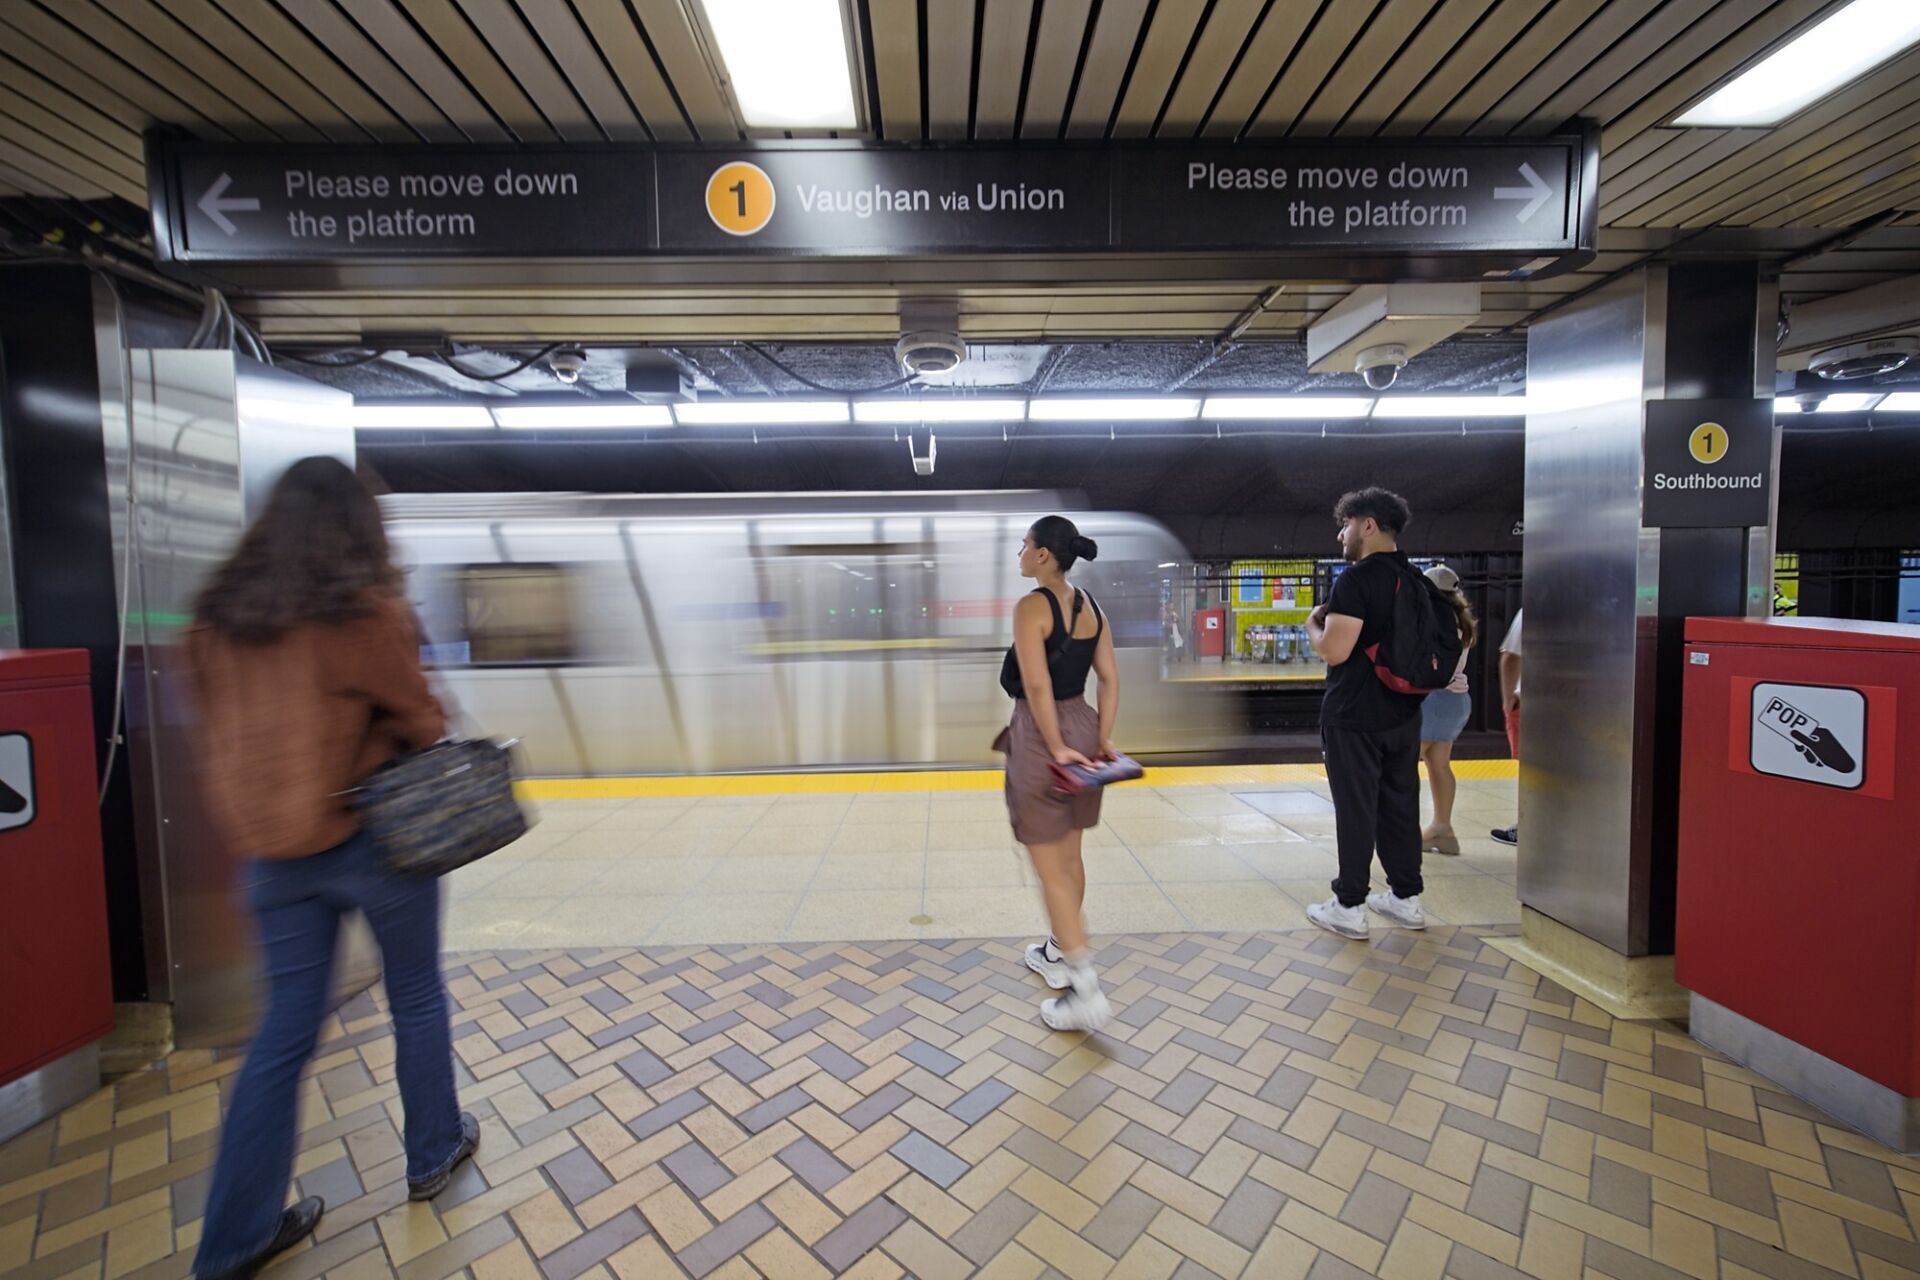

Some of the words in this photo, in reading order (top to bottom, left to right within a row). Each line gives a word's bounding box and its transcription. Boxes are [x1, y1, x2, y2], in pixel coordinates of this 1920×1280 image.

[286, 170, 389, 198] Please
[401, 173, 485, 197] move
[495, 168, 578, 196] down
[1188, 163, 1287, 189] Please
[1298, 168, 1378, 189] move
[1388, 163, 1468, 189] down
[729, 181, 747, 217] 1
[797, 184, 930, 218] Vaughan
[940, 192, 970, 211] via
[976, 183, 1065, 210] Union
[288, 210, 336, 237] the
[348, 209, 475, 243] platform
[1288, 201, 1334, 227] the
[1345, 200, 1467, 232] platform
[1703, 433, 1712, 453] 1
[1654, 473, 1762, 489] Southbound
[1767, 700, 1808, 728] POP
